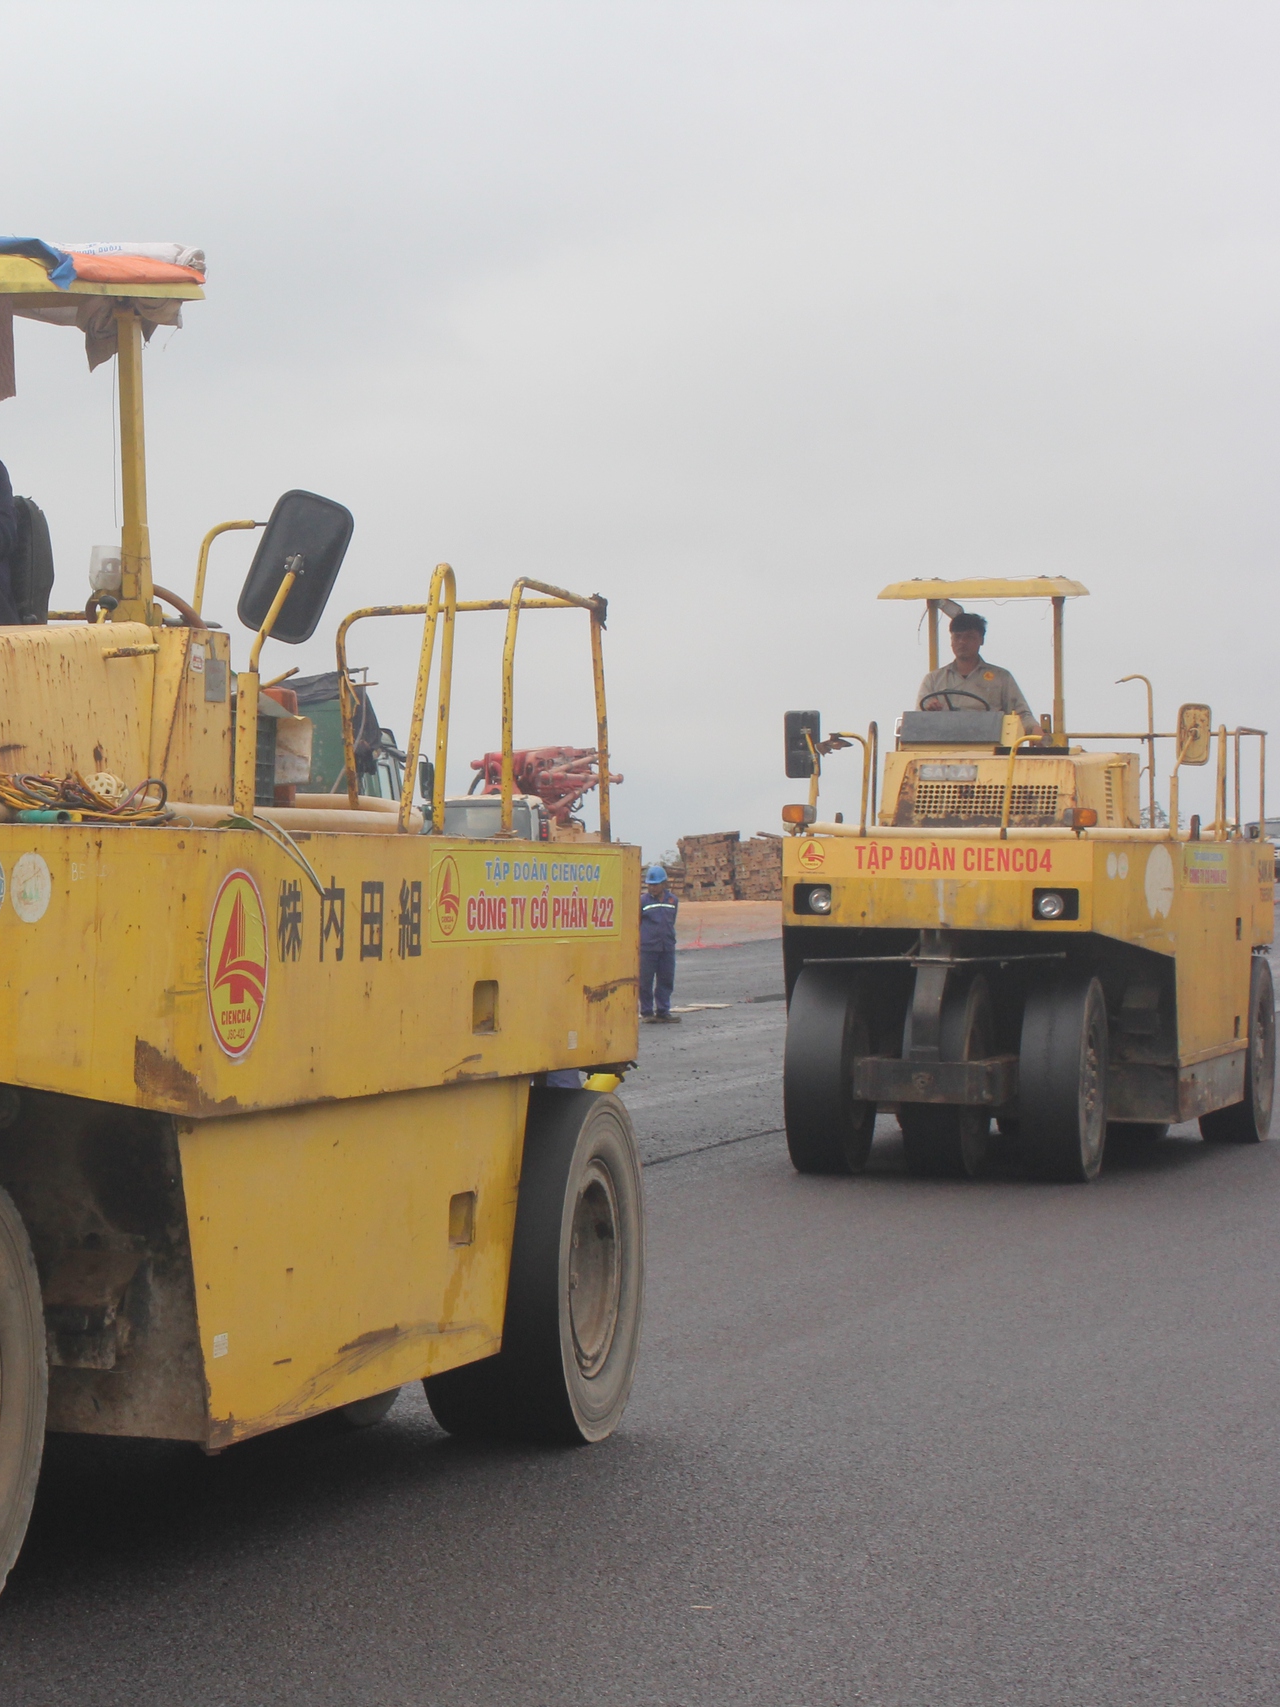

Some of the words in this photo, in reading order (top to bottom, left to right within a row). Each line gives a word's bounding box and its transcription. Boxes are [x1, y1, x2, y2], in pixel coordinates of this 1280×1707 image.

[485, 857, 510, 887] TẬP
[513, 857, 548, 882] ĐOÀN
[551, 863, 601, 883] CIENCO4
[854, 841, 894, 875] TẬP
[900, 841, 956, 871] ĐOÀN
[962, 847, 1053, 873] CIENCO4
[466, 888, 508, 933] CÔNG
[510, 896, 527, 931] TY
[530, 884, 551, 930] CỔ
[552, 885, 589, 930] PHẦN
[591, 896, 615, 929] 422
[221, 1008, 252, 1026] CIENCO4
